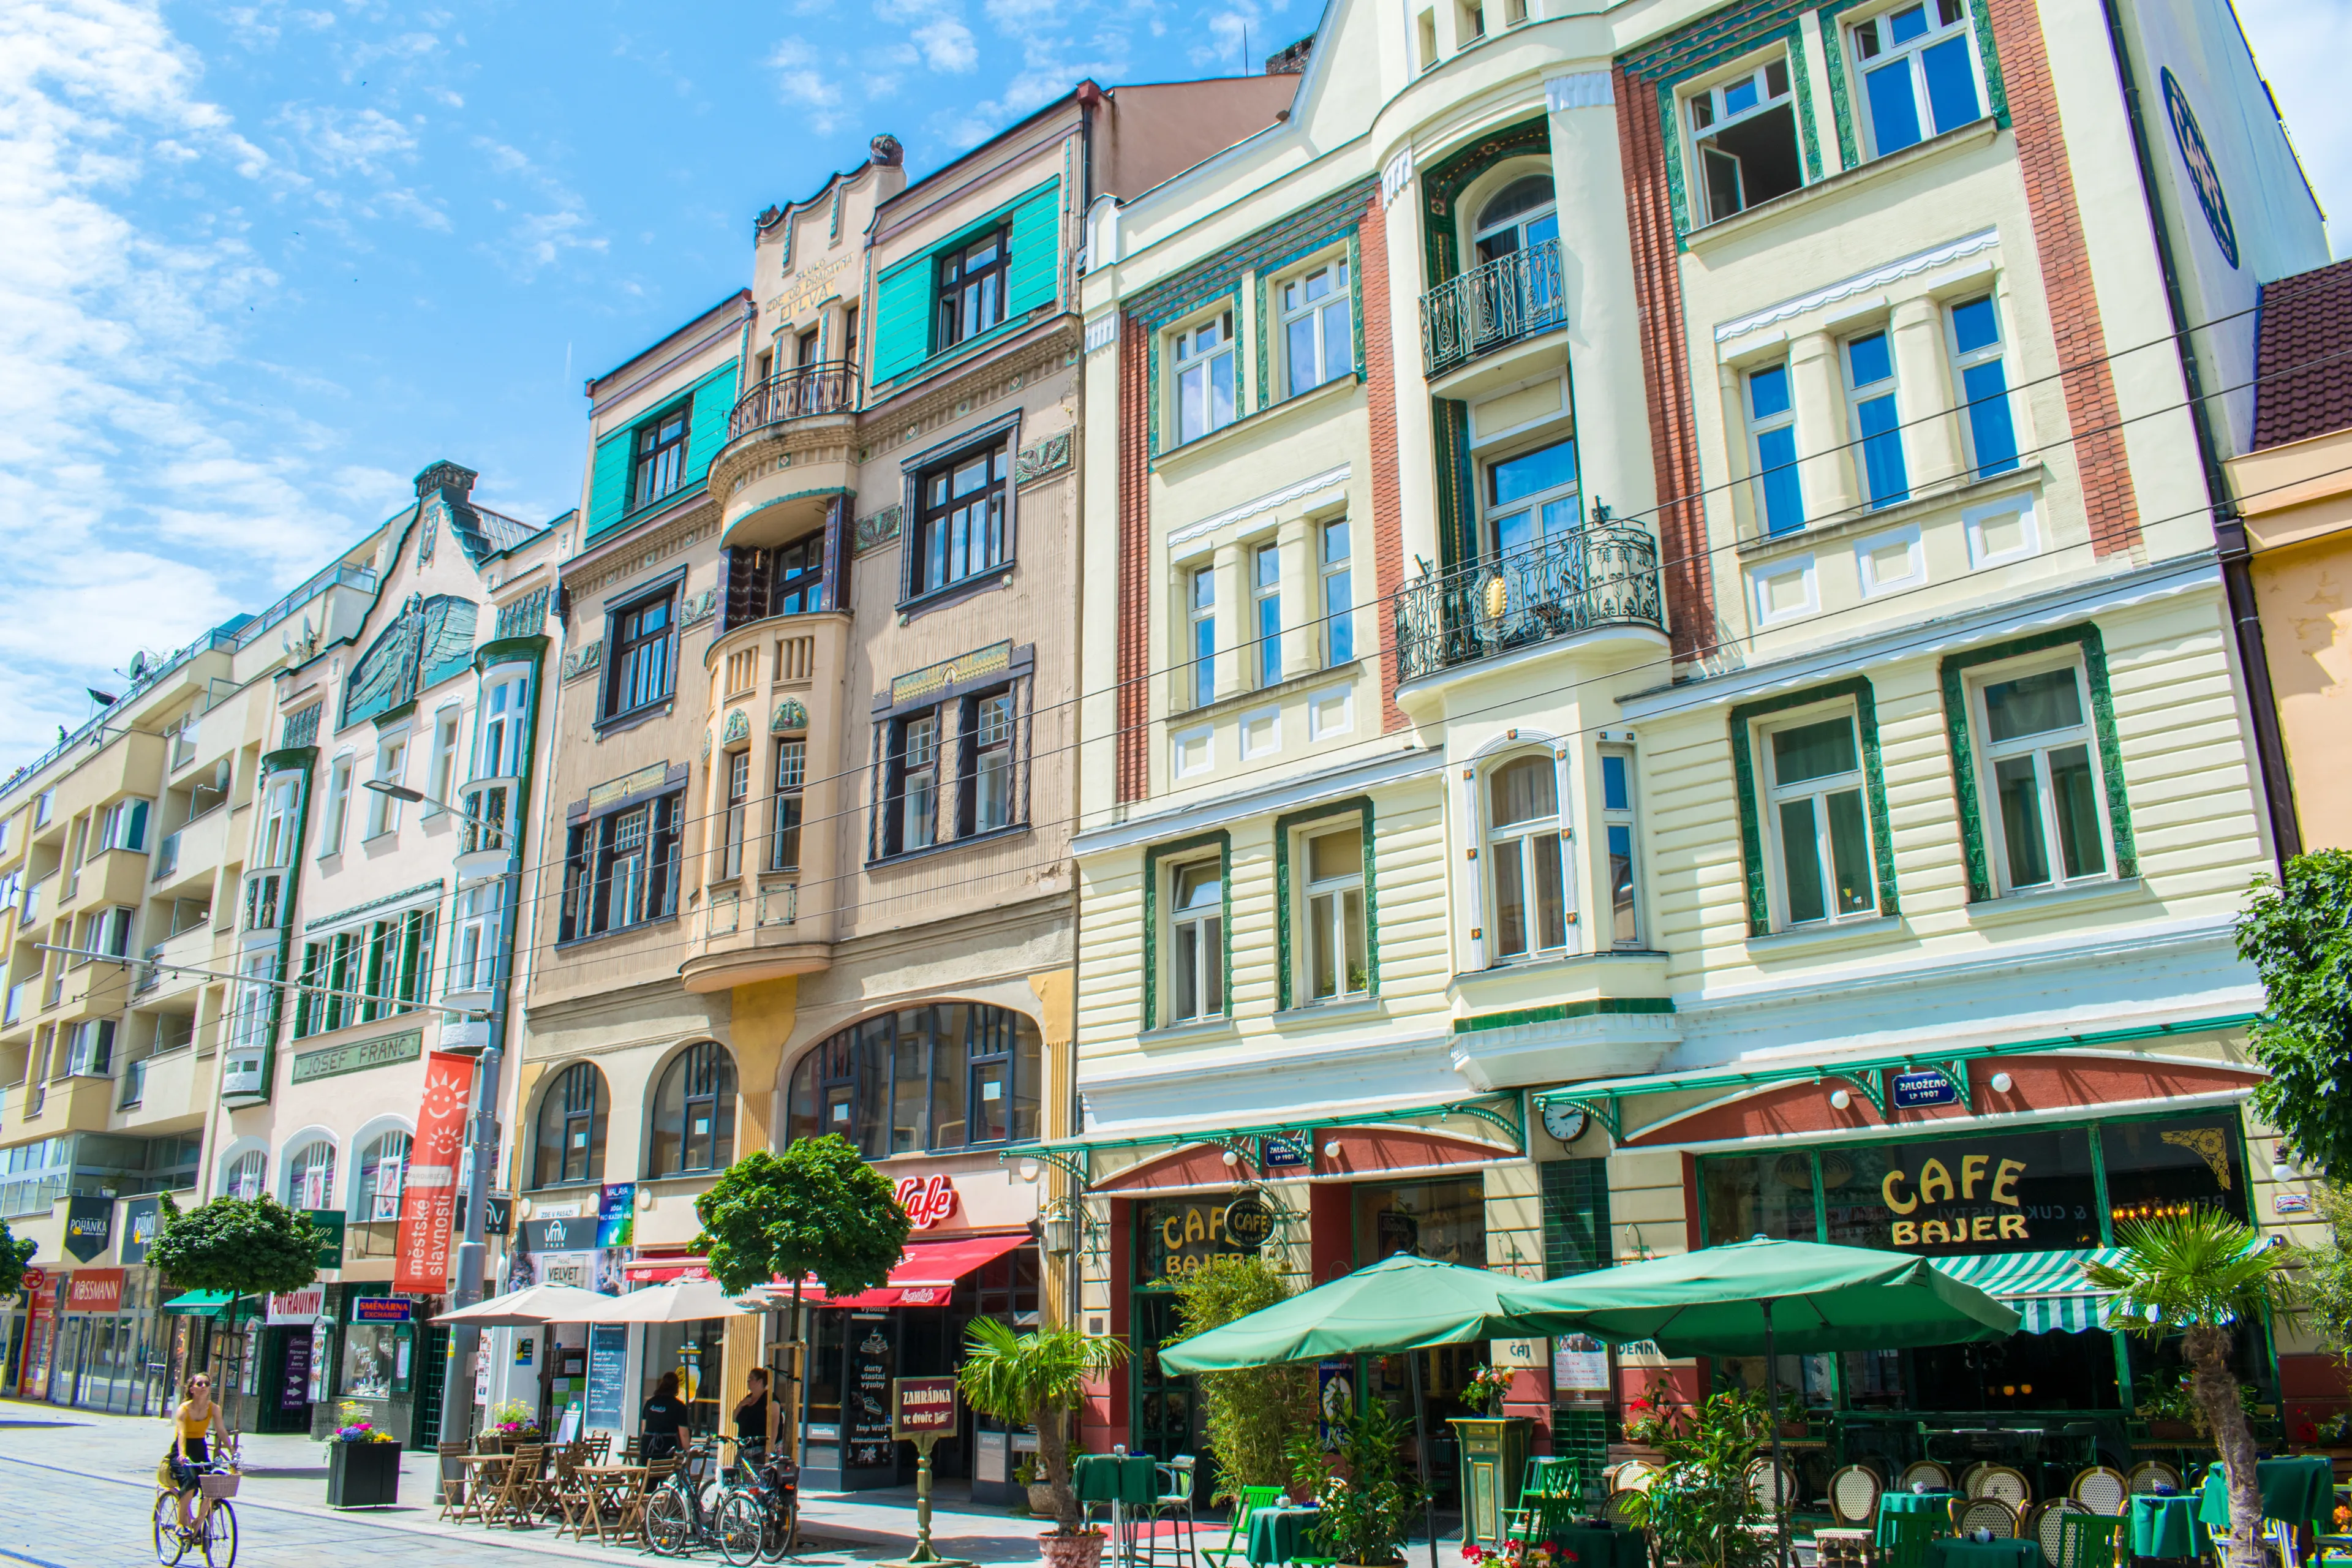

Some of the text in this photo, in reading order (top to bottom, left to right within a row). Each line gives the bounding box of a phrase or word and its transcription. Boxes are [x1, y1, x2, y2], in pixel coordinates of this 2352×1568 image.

[2172, 96, 2231, 243] CAFE
[304, 1038, 406, 1076] JOSEF FRANC
[1899, 1078, 1948, 1091] ZALOŽENO
[1882, 1155, 2027, 1215] CAFE
[70, 1219, 107, 1232] POHANKA
[1234, 1213, 1268, 1232] CAFE
[1892, 1214, 2029, 1245] BAJER
[407, 1199, 430, 1276] městské
[426, 1195, 451, 1276] slavnosti
[548, 1266, 579, 1280] VELVET
[74, 1280, 119, 1300] ROSSMANN
[901, 1289, 934, 1303] CrossCafe
[360, 1300, 409, 1311] SMĚNÁRNA
[1510, 1342, 1531, 1359] ČAJ
[861, 1381, 885, 1390] výroby
[903, 1386, 951, 1406] ZAHRÁDKA
[902, 1411, 933, 1425] ve dvoře
